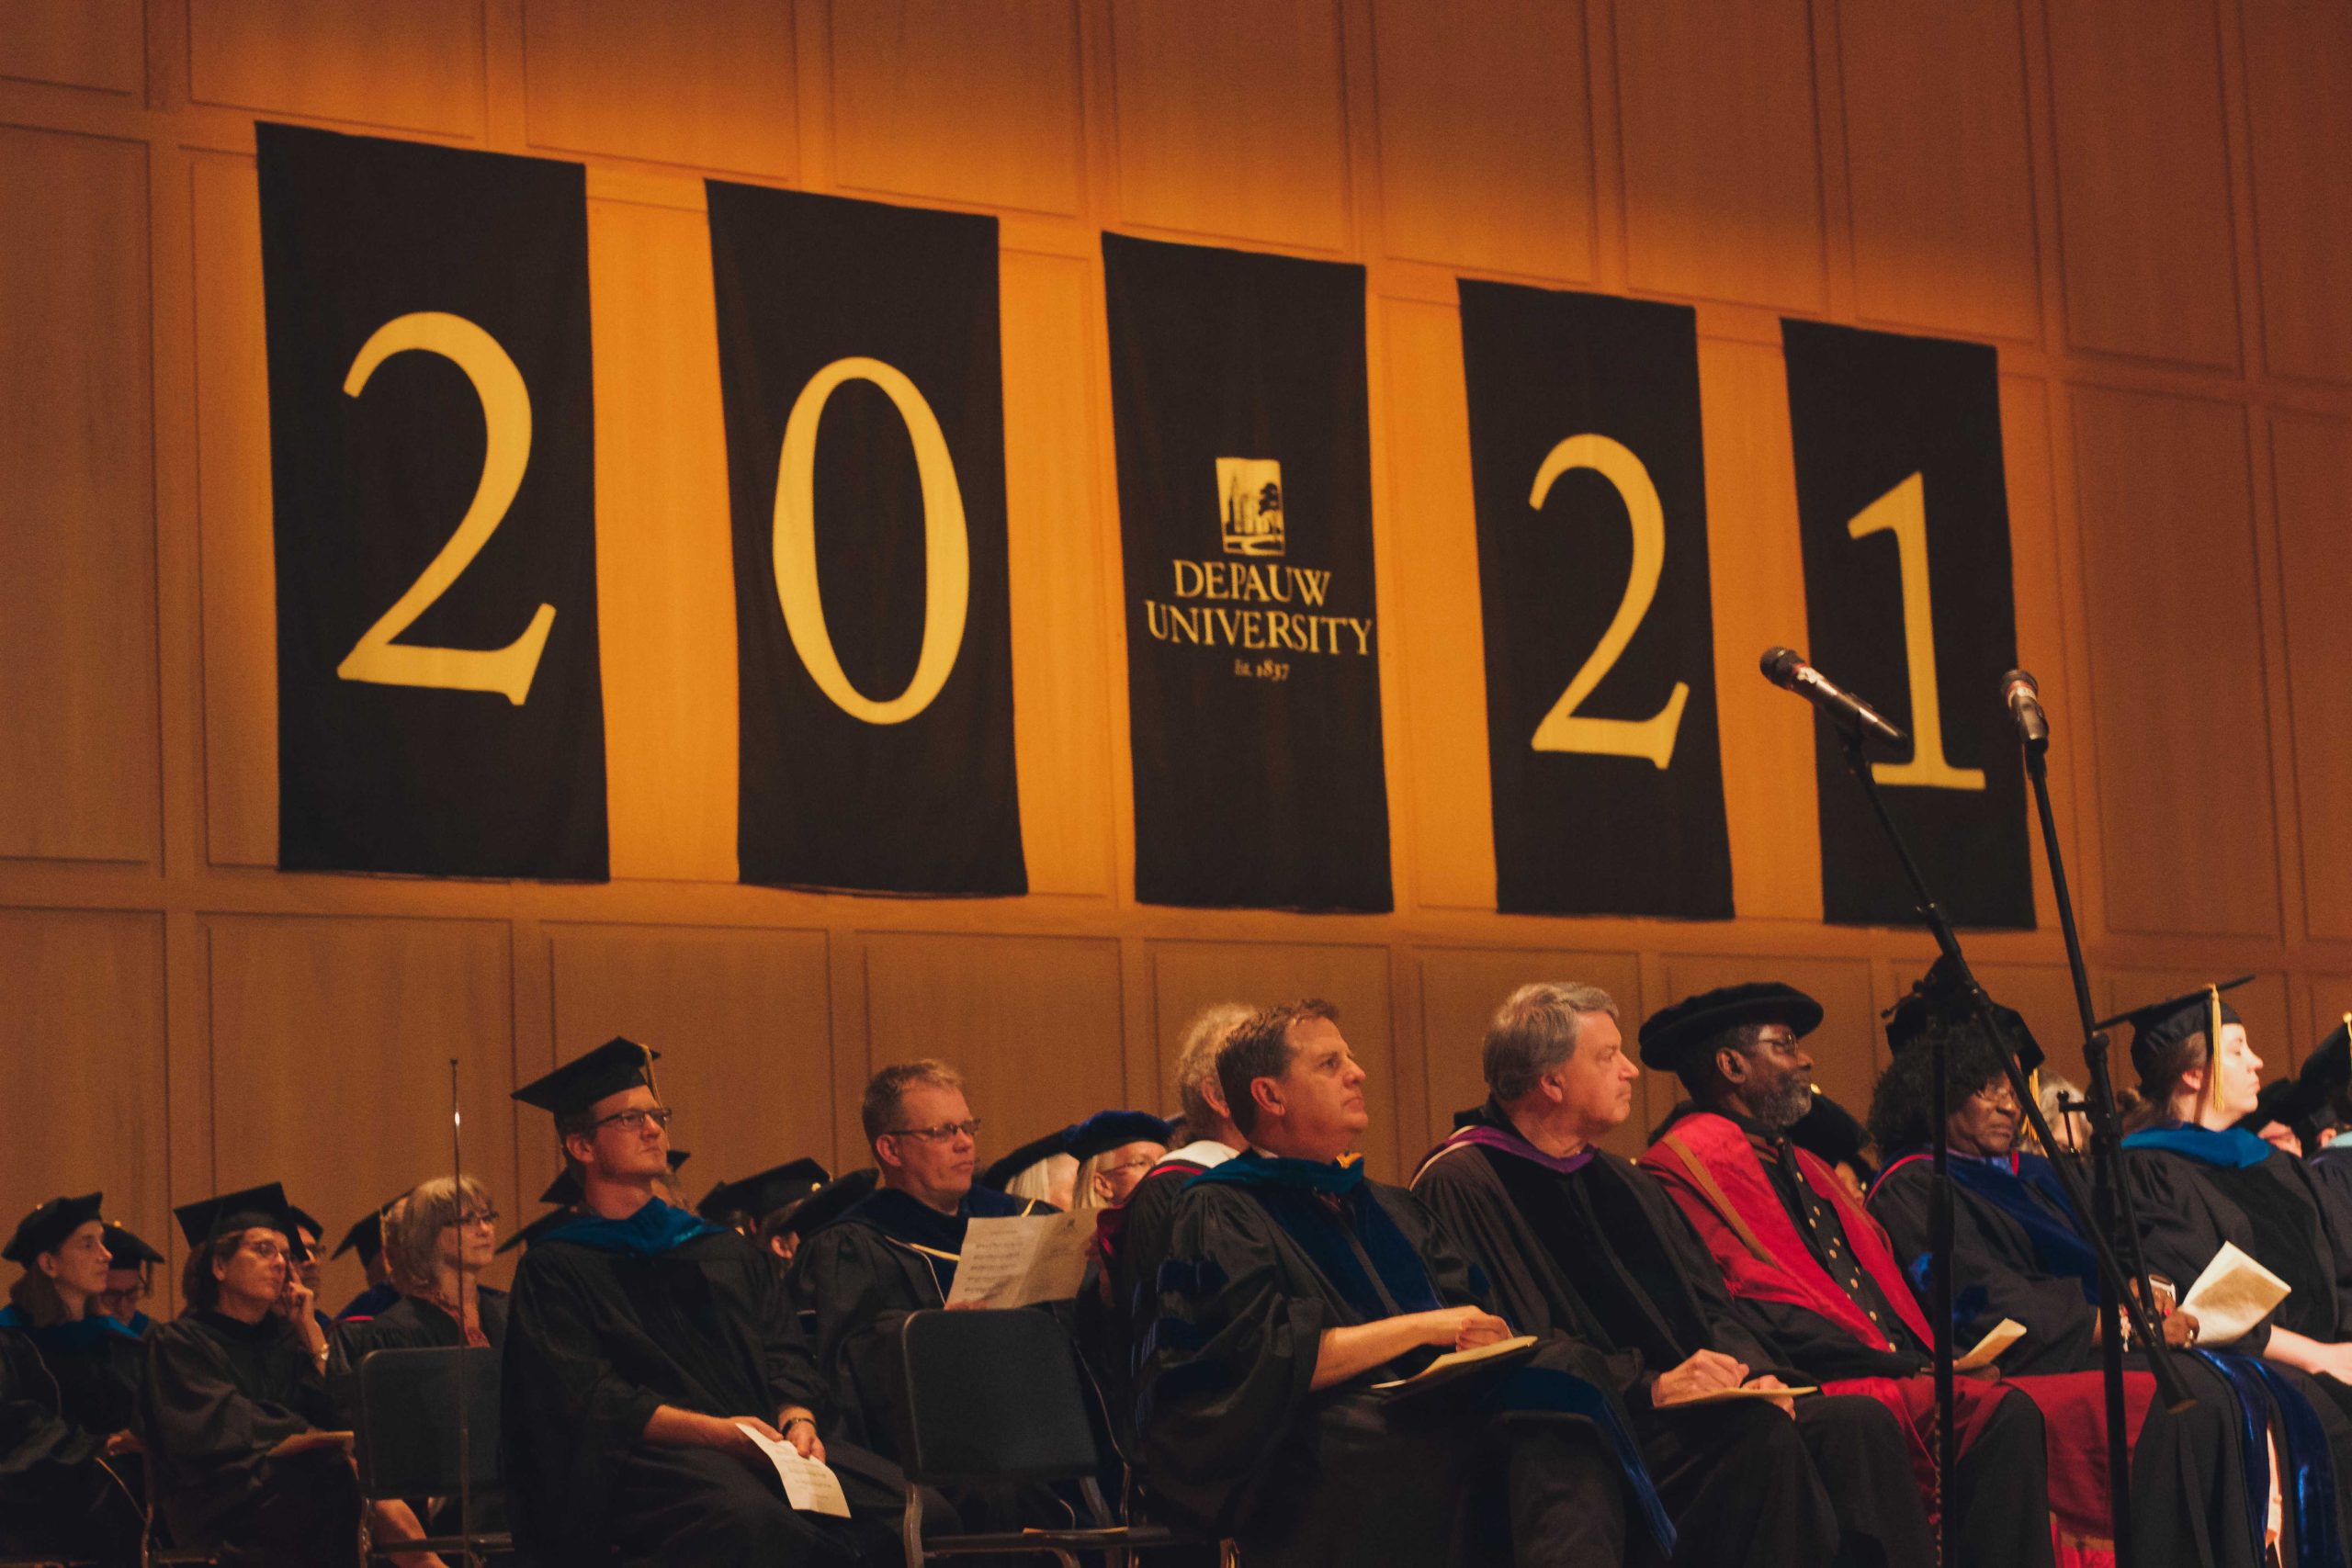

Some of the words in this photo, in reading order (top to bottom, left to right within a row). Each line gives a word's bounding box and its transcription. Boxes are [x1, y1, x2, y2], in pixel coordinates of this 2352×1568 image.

[337, 312, 557, 706] 2
[773, 356, 970, 726] 0
[1146, 600, 1372, 655] UNIVERSITY
[1173, 558, 1331, 606] DEPAUW
[1529, 434, 1690, 769] 2
[1848, 471, 1986, 790] 1
